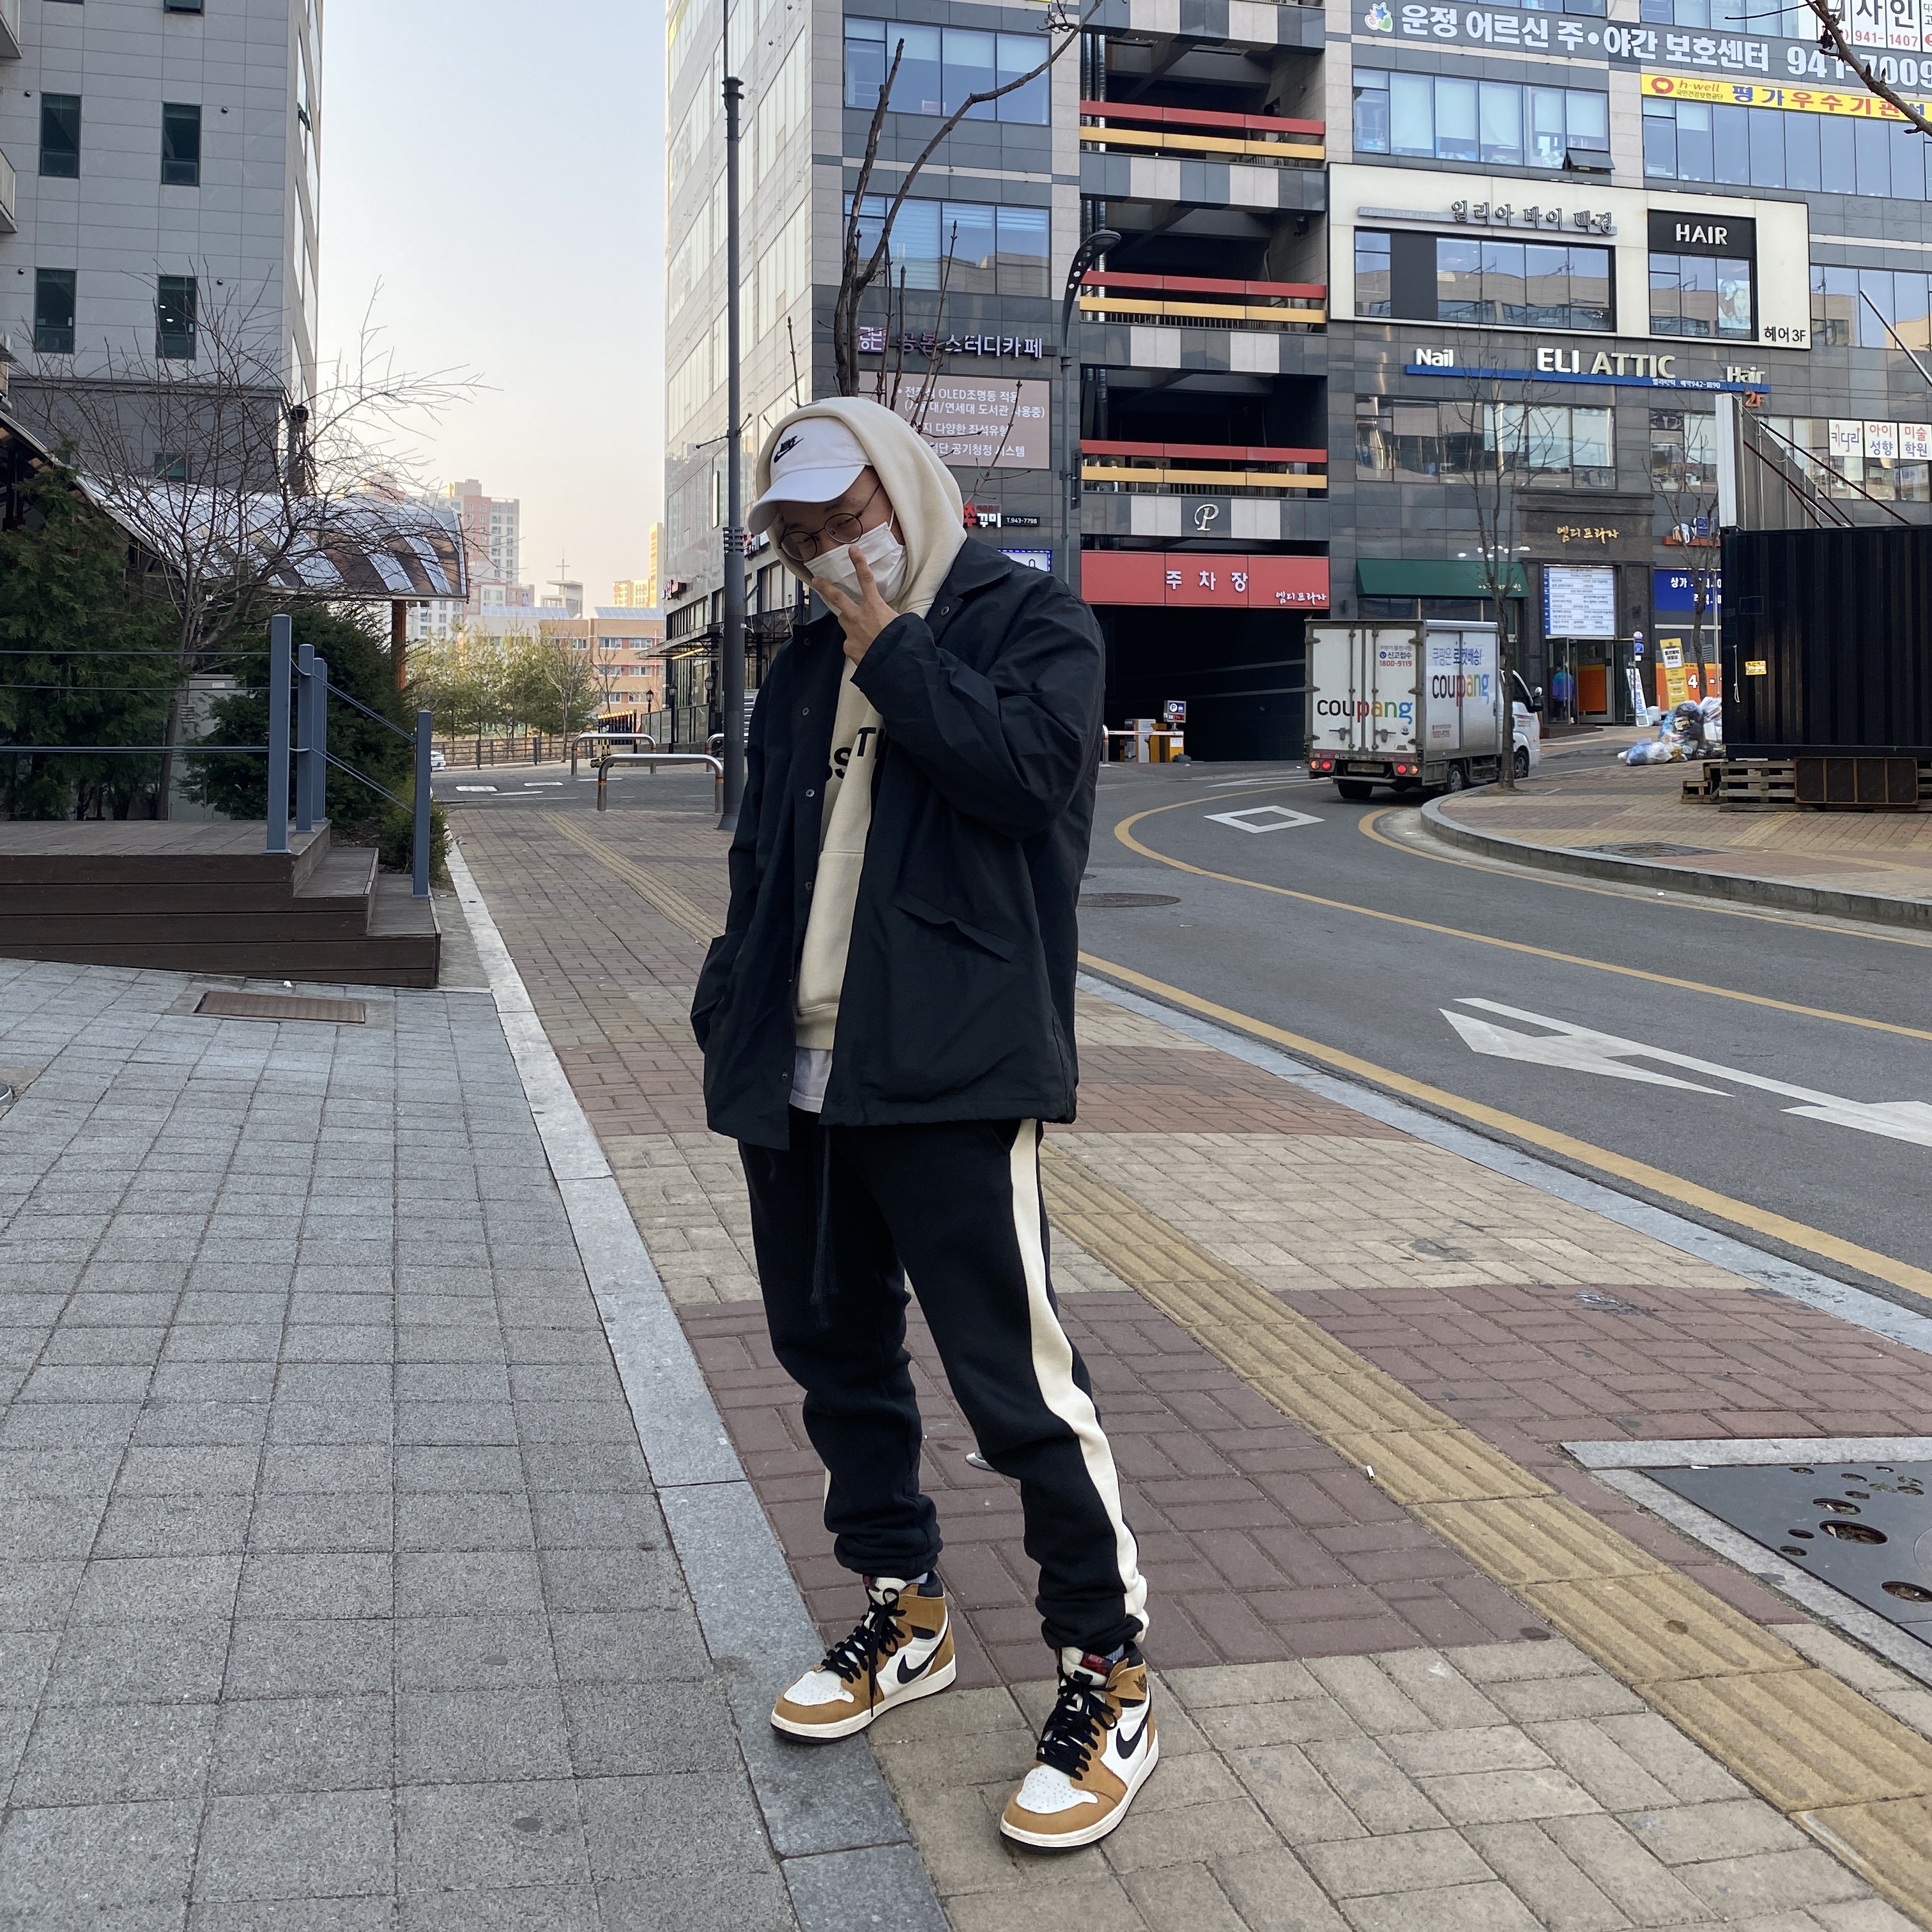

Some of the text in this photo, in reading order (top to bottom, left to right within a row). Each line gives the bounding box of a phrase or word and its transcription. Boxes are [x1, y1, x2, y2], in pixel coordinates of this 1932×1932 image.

[1402, 4, 1458, 38] 운정
[1466, 11, 1549, 48] 어르신
[1666, 33, 1769, 72] 보호센터
[1676, 224, 1728, 245] HAIR
[1764, 326, 1806, 342] 헤어 3F
[1414, 348, 1453, 367] Nail
[1537, 348, 1676, 379] ELI ATTIC
[1727, 365, 1765, 384] Hair
[939, 388, 997, 402] OLED조명등
[999, 391, 1020, 403] 적용
[1745, 391, 1765, 408] 2F
[978, 403, 1008, 416] 도서관
[936, 423, 966, 435] 다양한
[1869, 424, 1927, 441] 아이 미술
[952, 443, 992, 456] 공기청정
[995, 445, 1025, 457] 시스템
[1870, 441, 1927, 457] 성향 학원
[1193, 503, 1220, 531] P
[1671, 576, 1687, 588] 상가
[1432, 648, 1452, 666] 쿠팡은
[1432, 673, 1489, 707] coupang
[1317, 699, 1413, 725] coupang
